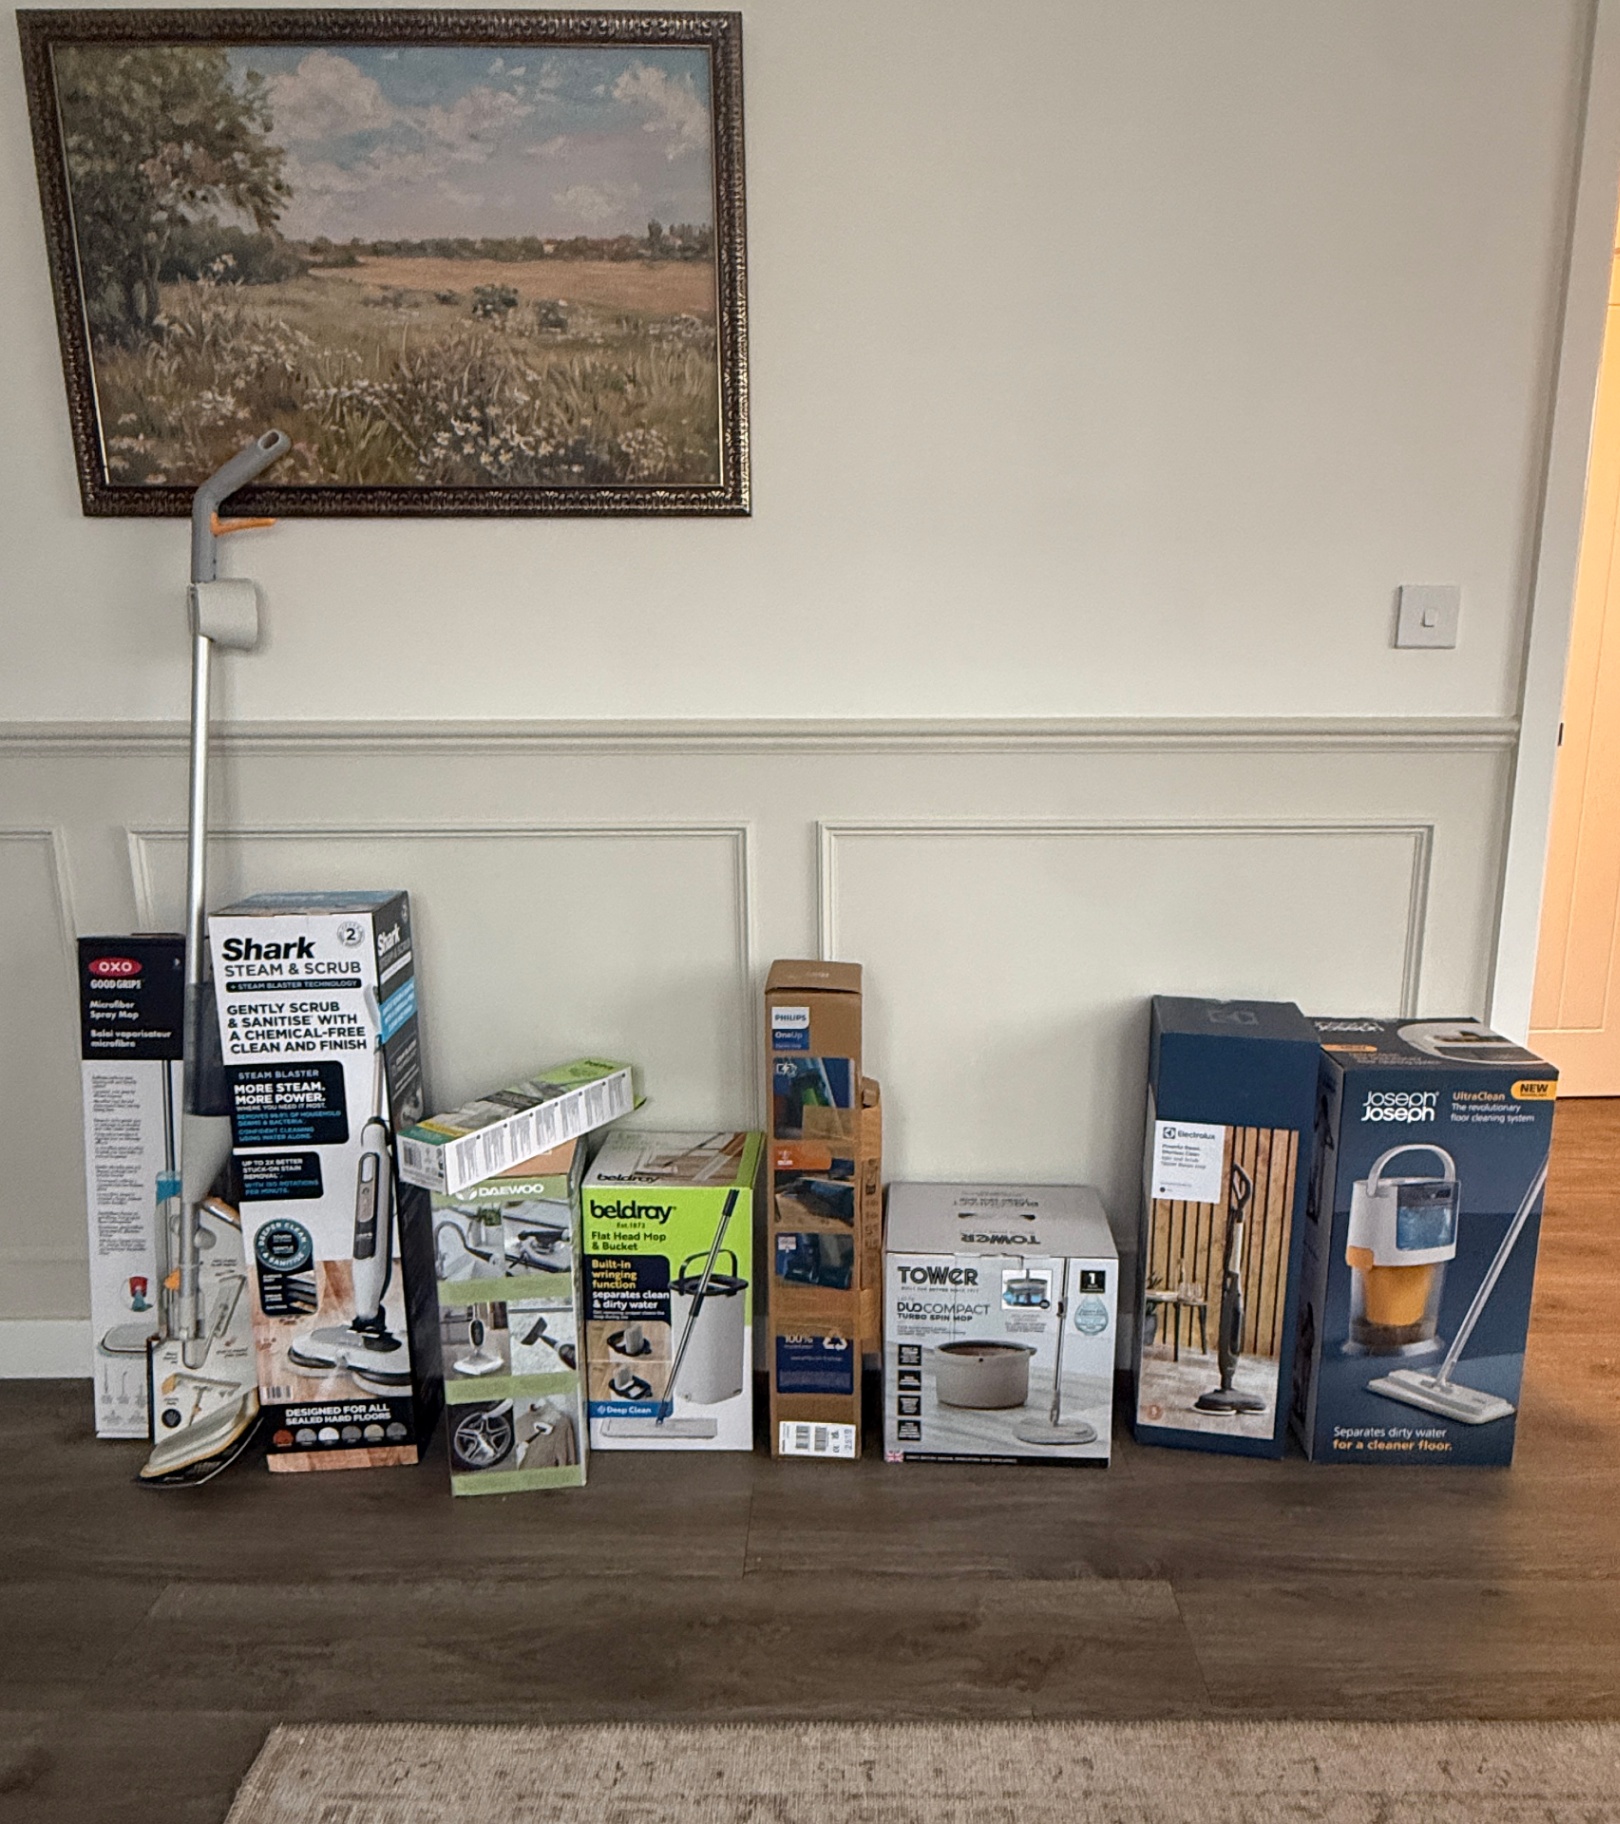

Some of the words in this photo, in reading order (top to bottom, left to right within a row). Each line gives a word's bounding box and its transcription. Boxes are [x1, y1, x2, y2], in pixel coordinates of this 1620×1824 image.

[346, 928, 356, 940] 2
[222, 936, 316, 961] Shark
[99, 962, 132, 972] OXO
[224, 964, 284, 978] STEAM
[288, 963, 299, 974] &
[305, 962, 362, 974] SCRUB
[90, 979, 116, 989] GOOD
[266, 982, 302, 990] BLASTER
[90, 1000, 135, 1008] Microfiber
[227, 1003, 284, 1016] GENTLY
[290, 1002, 340, 1013] SCRUB
[90, 1010, 116, 1020] Spray
[118, 1010, 139, 1020] Mop
[228, 1018, 238, 1028] &
[318, 1014, 358, 1024] WITH
[90, 1029, 114, 1038] Balai
[229, 1031, 240, 1042] A
[245, 1026, 366, 1040] CHEMICAL-FREE
[775, 1032, 803, 1040] OneUp
[231, 1042, 280, 1054] CLEAN
[284, 1040, 316, 1052] AND
[320, 1040, 367, 1050] FINISH
[238, 1072, 272, 1080] STEAM
[275, 1070, 319, 1078] BLASTER
[234, 1084, 274, 1094] MORE
[276, 1082, 326, 1092] STEAM.
[1520, 1084, 1548, 1092] NEW
[235, 1094, 274, 1105] MORE
[275, 1093, 326, 1102] POWER.
[1363, 1091, 1434, 1107] Joseph
[1452, 1092, 1505, 1101] UltraClean
[1468, 1103, 1520, 1112] revolutionary
[1361, 1106, 1434, 1123] Joseph
[1472, 1114, 1505, 1123] cleaning
[1178, 1130, 1215, 1140] Electrolux
[597, 1173, 660, 1183] beldray
[478, 1184, 544, 1197] DAEWOO
[590, 1200, 672, 1224] beldray
[592, 1232, 610, 1240] Flat
[614, 1232, 640, 1240] Head
[644, 1232, 666, 1242] Mop
[961, 1232, 1040, 1245] TOWER
[592, 1242, 599, 1250] &
[602, 1242, 638, 1250] Bucket
[592, 1260, 631, 1269] Built-in
[592, 1270, 637, 1280] wringing
[898, 1266, 978, 1286] TOWER
[1089, 1272, 1096, 1284] 1
[592, 1280, 636, 1288] function
[592, 1290, 640, 1300] separates
[642, 1290, 670, 1299] clean
[592, 1299, 600, 1308] &
[602, 1300, 628, 1310] dirty
[629, 1300, 658, 1309] water
[286, 1406, 341, 1417] DESIGNED
[343, 1405, 366, 1414] FOR
[369, 1404, 390, 1412] ALL
[606, 1406, 628, 1414] Deep
[629, 1405, 651, 1414] Clean
[286, 1416, 322, 1425] SEALED
[354, 1412, 391, 1421] FLOORS
[1334, 1426, 1386, 1438] Separates
[1388, 1427, 1412, 1439] dirty
[1415, 1428, 1447, 1438] water
[1333, 1439, 1352, 1450] for
[1367, 1440, 1414, 1450] cleaner
[1418, 1440, 1452, 1450] floor.
